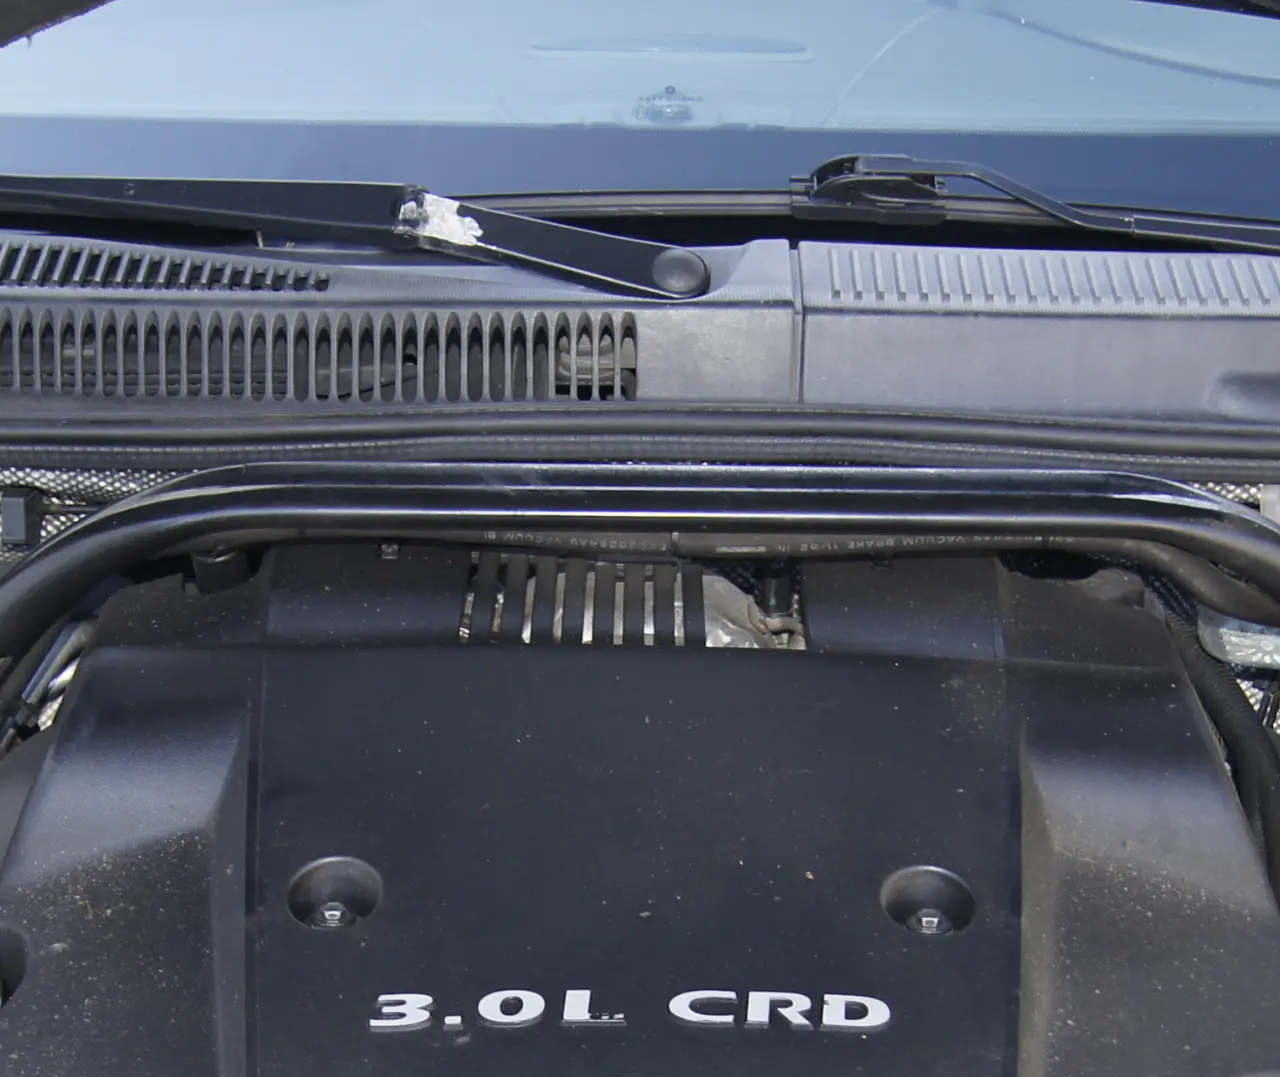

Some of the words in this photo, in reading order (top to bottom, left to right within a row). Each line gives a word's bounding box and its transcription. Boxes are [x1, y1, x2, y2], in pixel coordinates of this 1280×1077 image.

[847, 537, 895, 549] BRAKE
[902, 535, 965, 546] VACUUM
[369, 989, 626, 1027] 3.0L
[669, 989, 891, 1028] CRD
